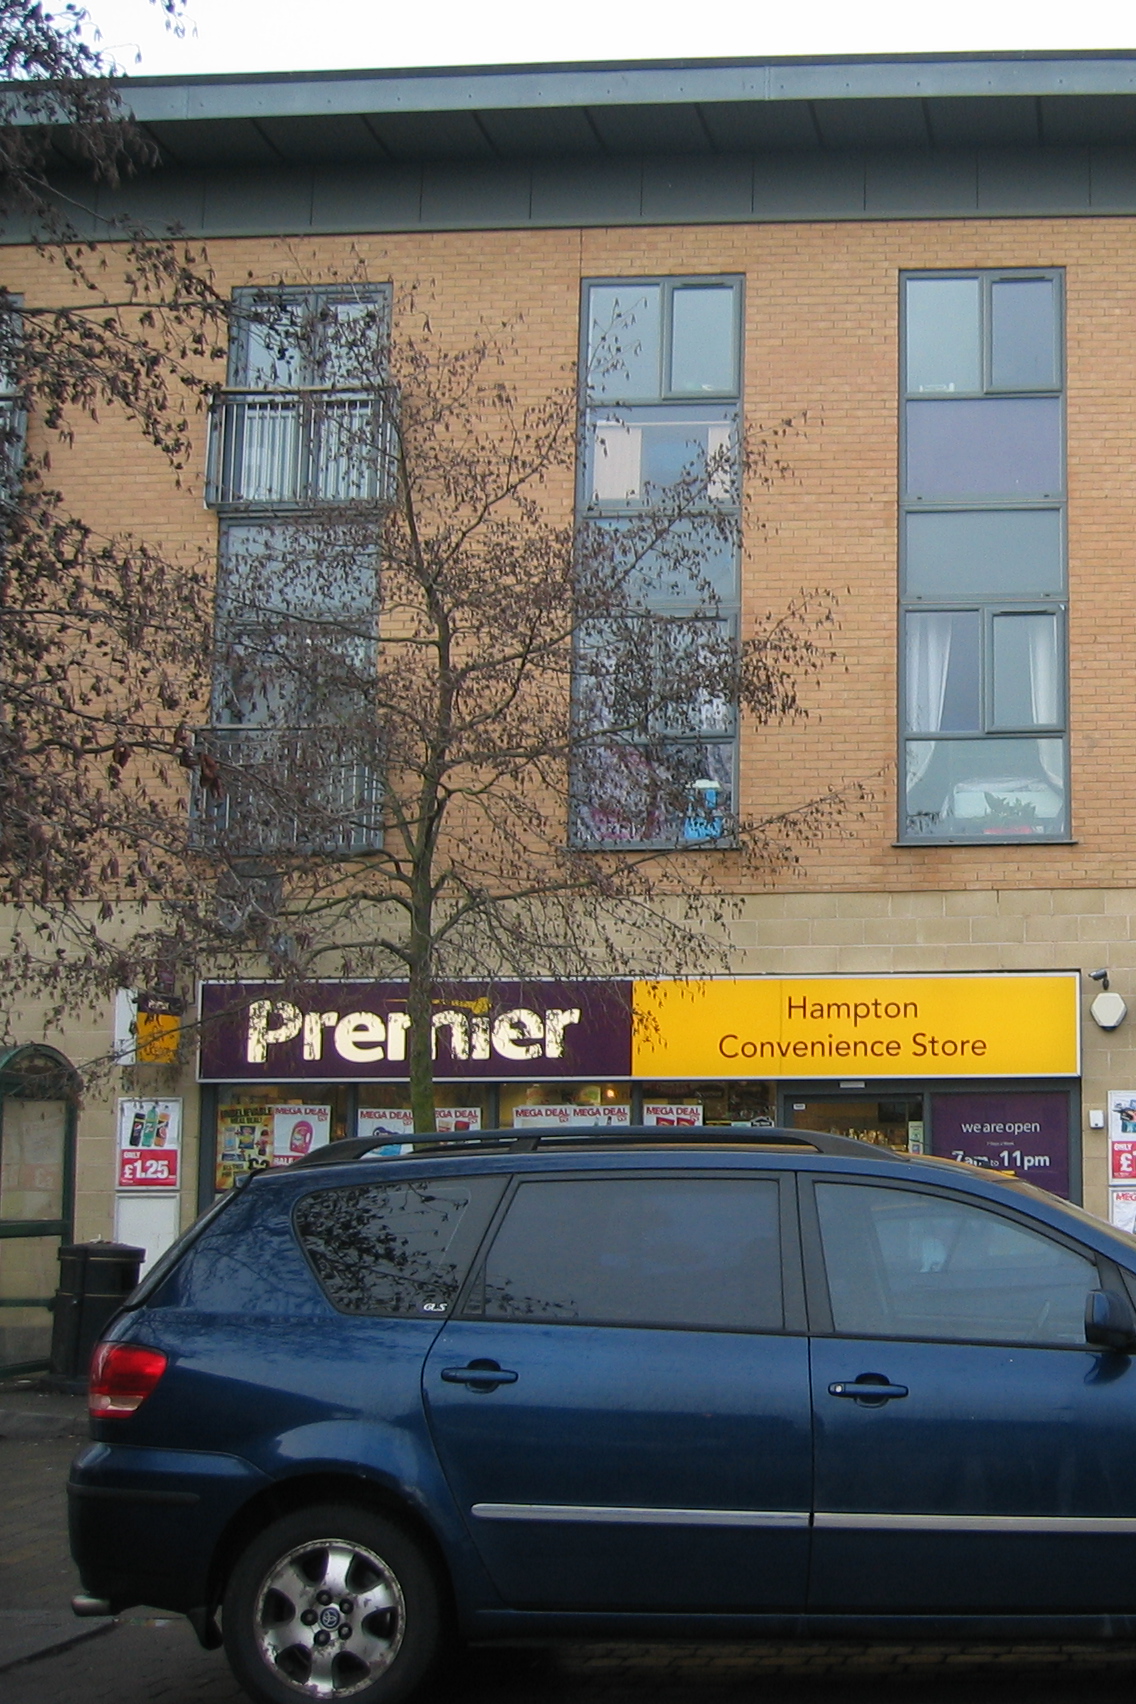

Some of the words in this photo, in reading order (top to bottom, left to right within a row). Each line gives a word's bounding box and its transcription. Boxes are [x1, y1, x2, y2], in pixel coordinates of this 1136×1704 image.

[787, 996, 918, 1027] Hampton
[247, 998, 582, 1063] Premier
[719, 1033, 901, 1058] Convenience
[912, 1032, 987, 1057] Store
[275, 1107, 302, 1115] MEGA
[360, 1110, 388, 1119] MEGA
[389, 1110, 413, 1119] DEAL
[435, 1110, 452, 1118] EGA
[455, 1110, 478, 1118] DEAL
[515, 1109, 543, 1117] MEGA
[545, 1108, 570, 1116] DEAL
[573, 1108, 600, 1117] MEGA
[603, 1107, 628, 1116] DEAL
[646, 1107, 673, 1115] MEGA
[676, 1107, 700, 1116] DEAL
[961, 1123, 981, 1133] we
[982, 1123, 1003, 1133] are
[1006, 1122, 1040, 1135] open
[1114, 1143, 1132, 1151] ONLY
[1000, 1150, 1050, 1170] 11pm
[124, 1160, 169, 1178] £1.25
[423, 1302, 447, 1311] GLS
